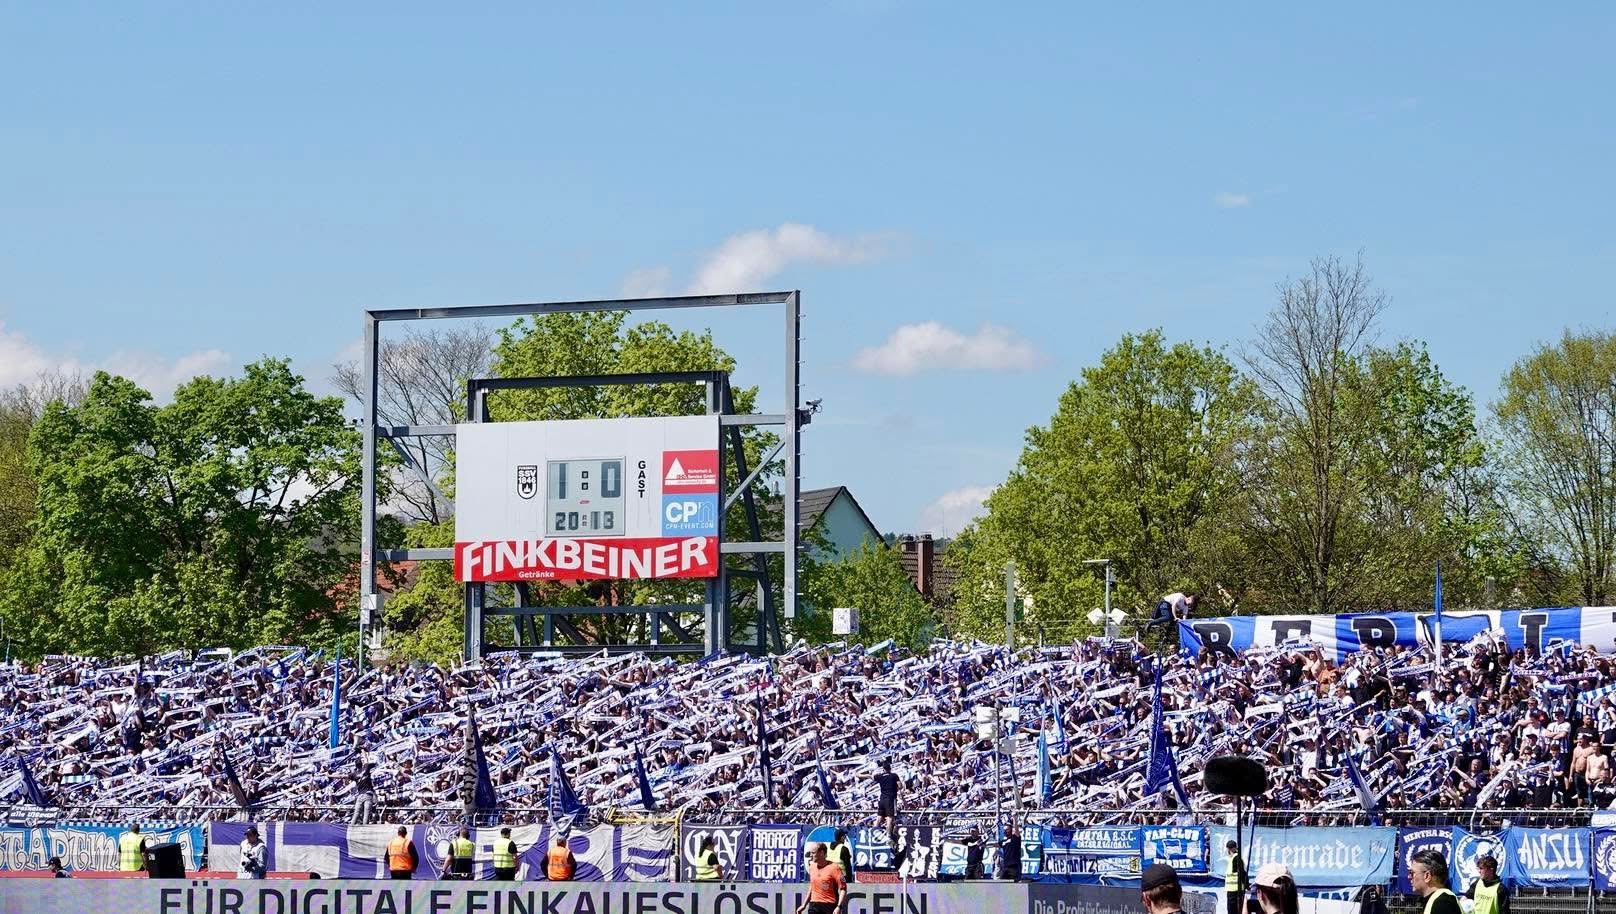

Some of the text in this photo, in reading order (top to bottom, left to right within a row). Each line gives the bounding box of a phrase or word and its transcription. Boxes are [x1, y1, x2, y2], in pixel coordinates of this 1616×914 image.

[638, 460, 646, 498] GAST
[463, 537, 708, 582] FINKBEINER
[1145, 828, 1199, 840] FAN-CLUB
[1403, 829, 1437, 843] HERTHA
[1518, 832, 1583, 870] ANSU
[160, 881, 244, 914] FÜR
